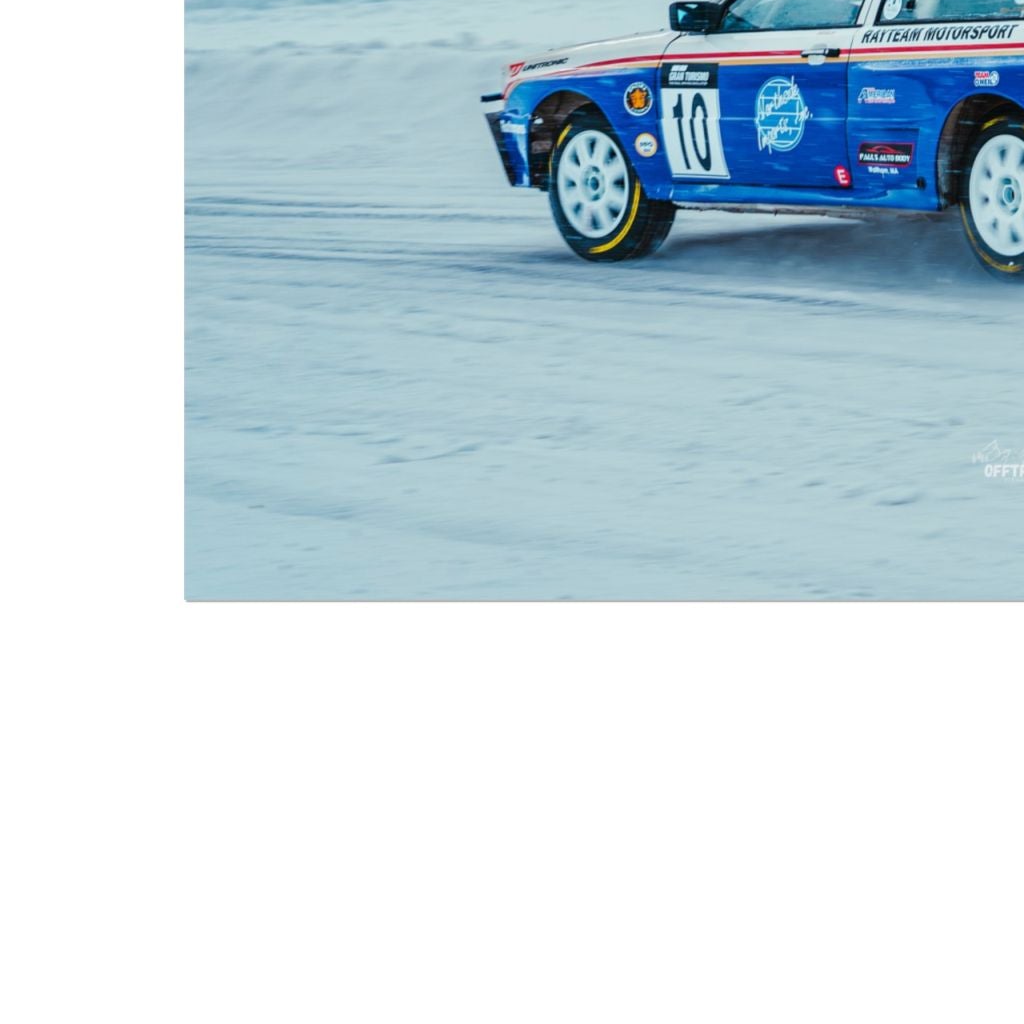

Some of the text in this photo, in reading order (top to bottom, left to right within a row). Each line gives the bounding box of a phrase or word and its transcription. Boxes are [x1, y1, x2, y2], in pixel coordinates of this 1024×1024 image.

[861, 24, 1019, 43] RAYTEAM MOTORSPORT
[672, 92, 711, 172] 10
[836, 168, 848, 184] E
